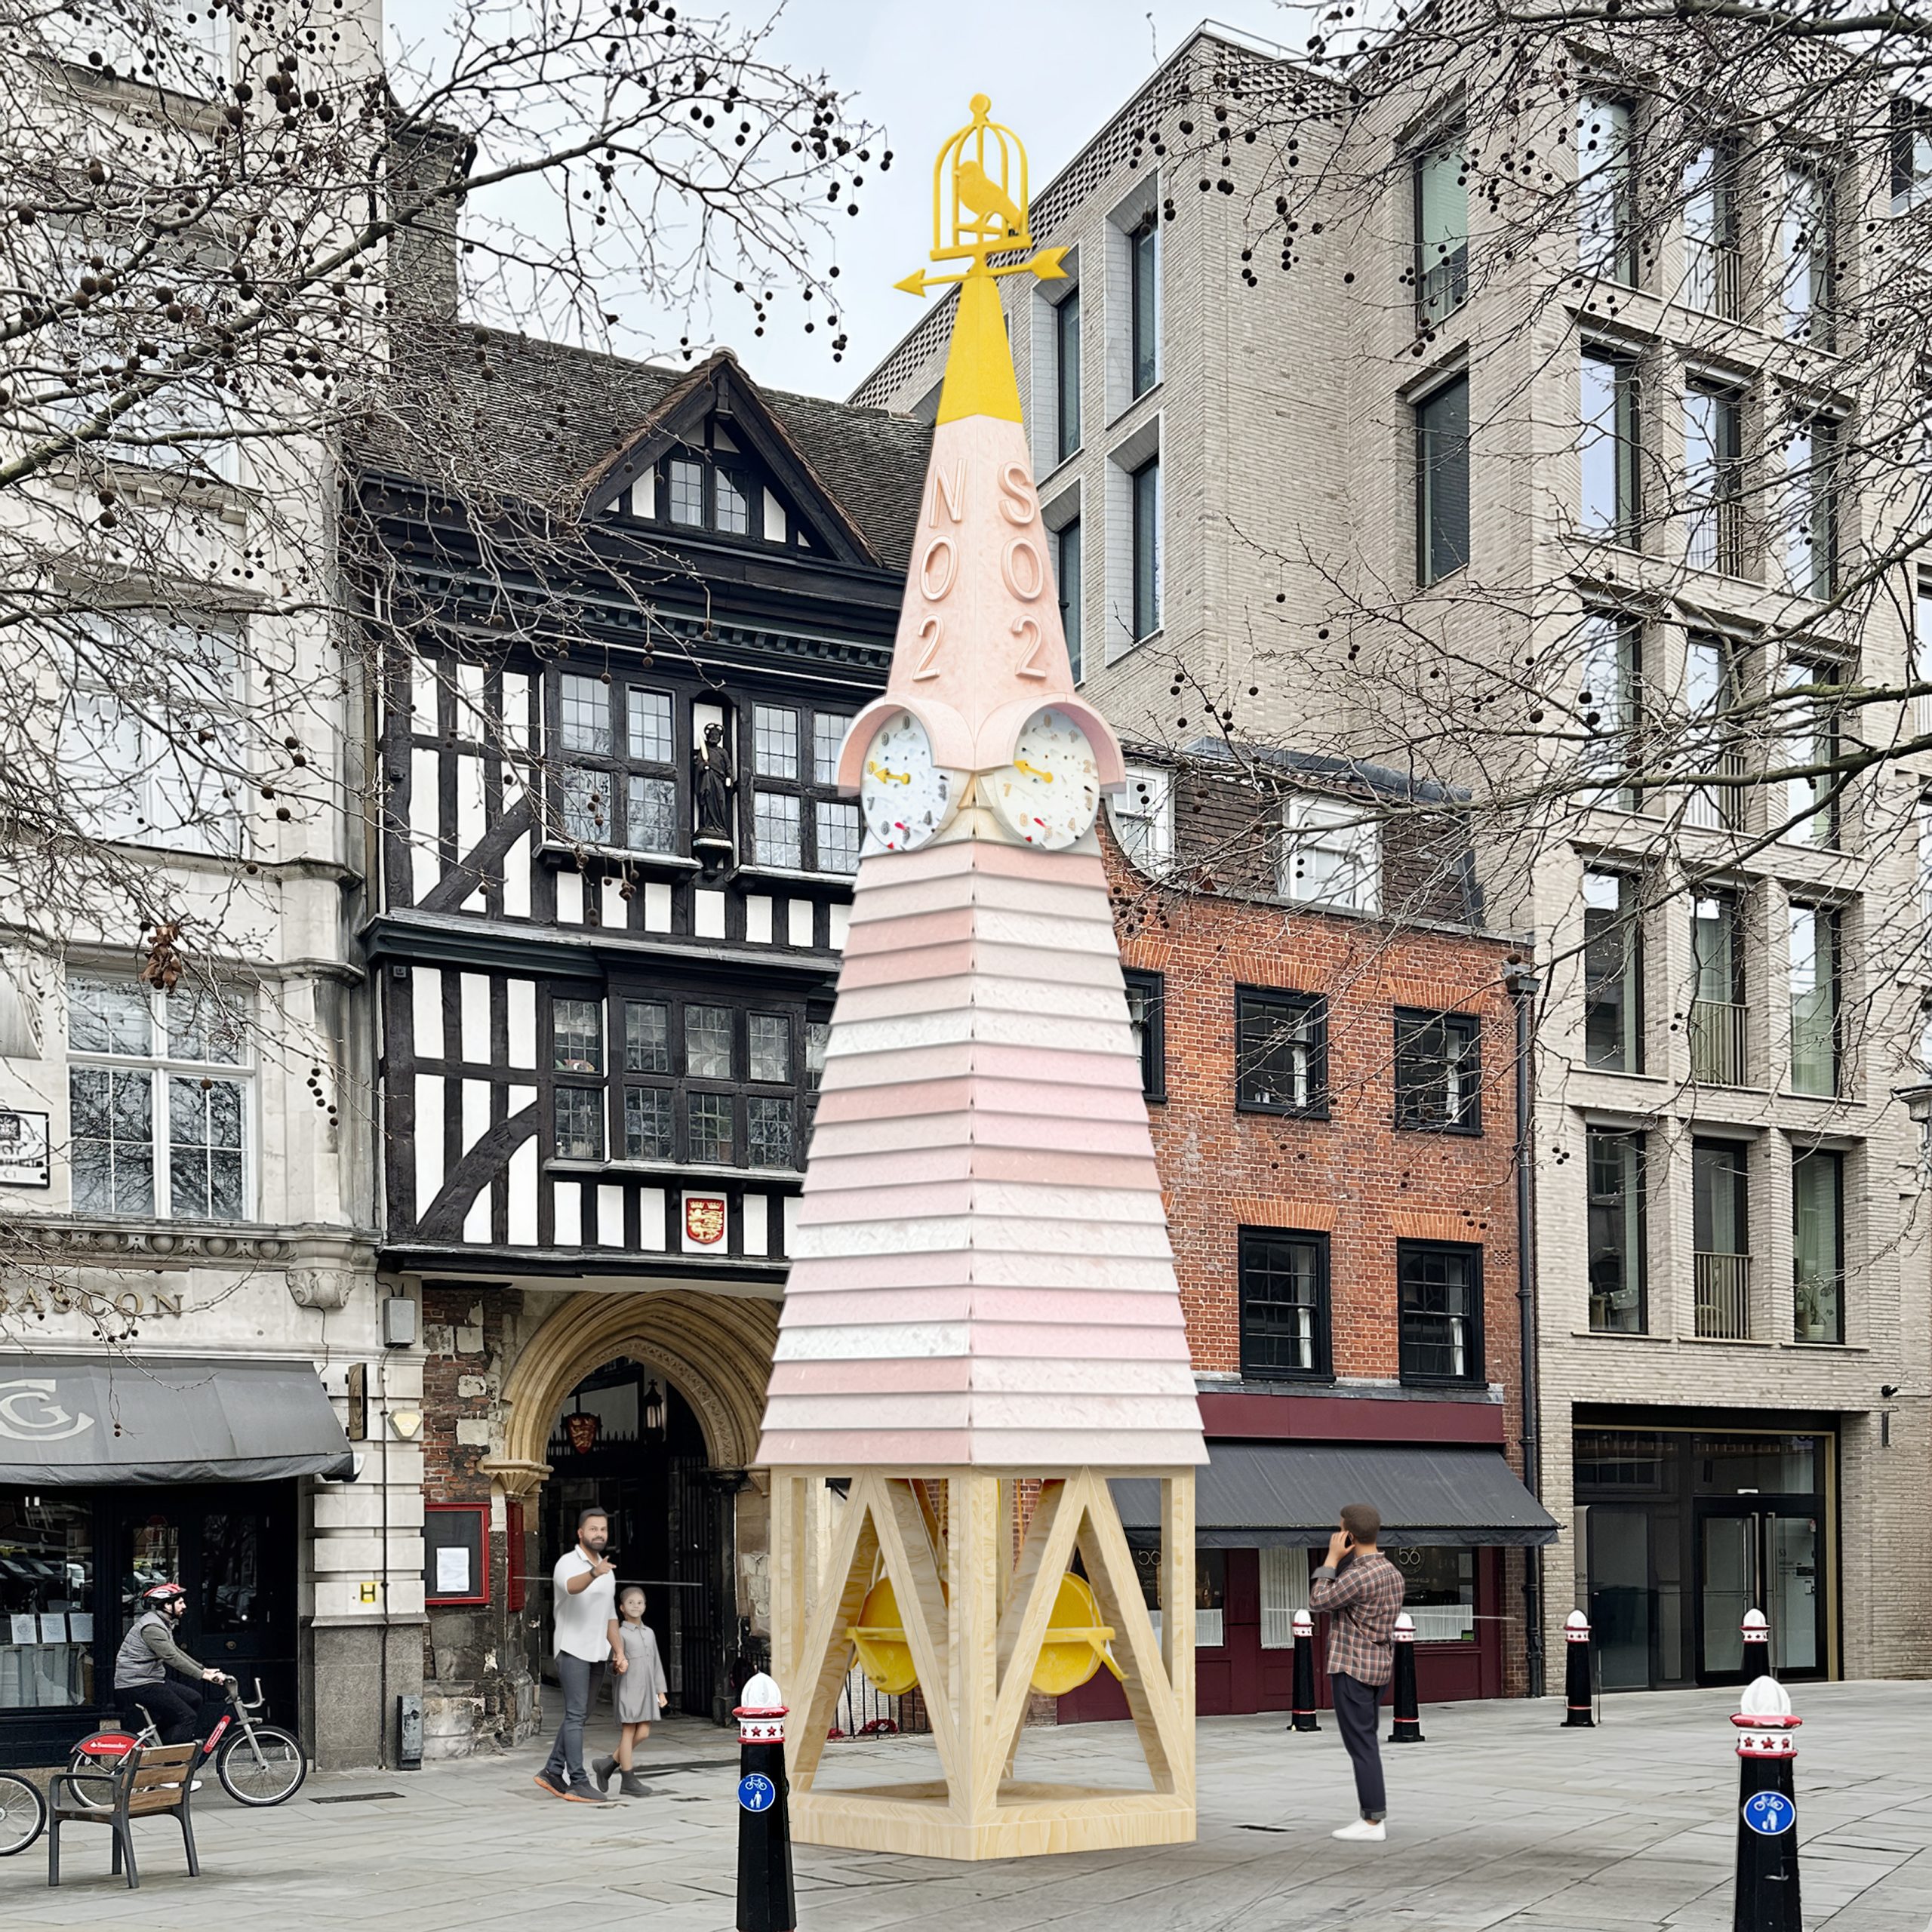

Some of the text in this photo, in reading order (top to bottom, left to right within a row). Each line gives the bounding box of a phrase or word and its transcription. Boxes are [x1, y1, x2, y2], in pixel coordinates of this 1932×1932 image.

[1083, 758, 1092, 773] 2
[1003, 783, 1012, 797] 7
[867, 796, 875, 811] 7
[361, 1584, 375, 1601] H
